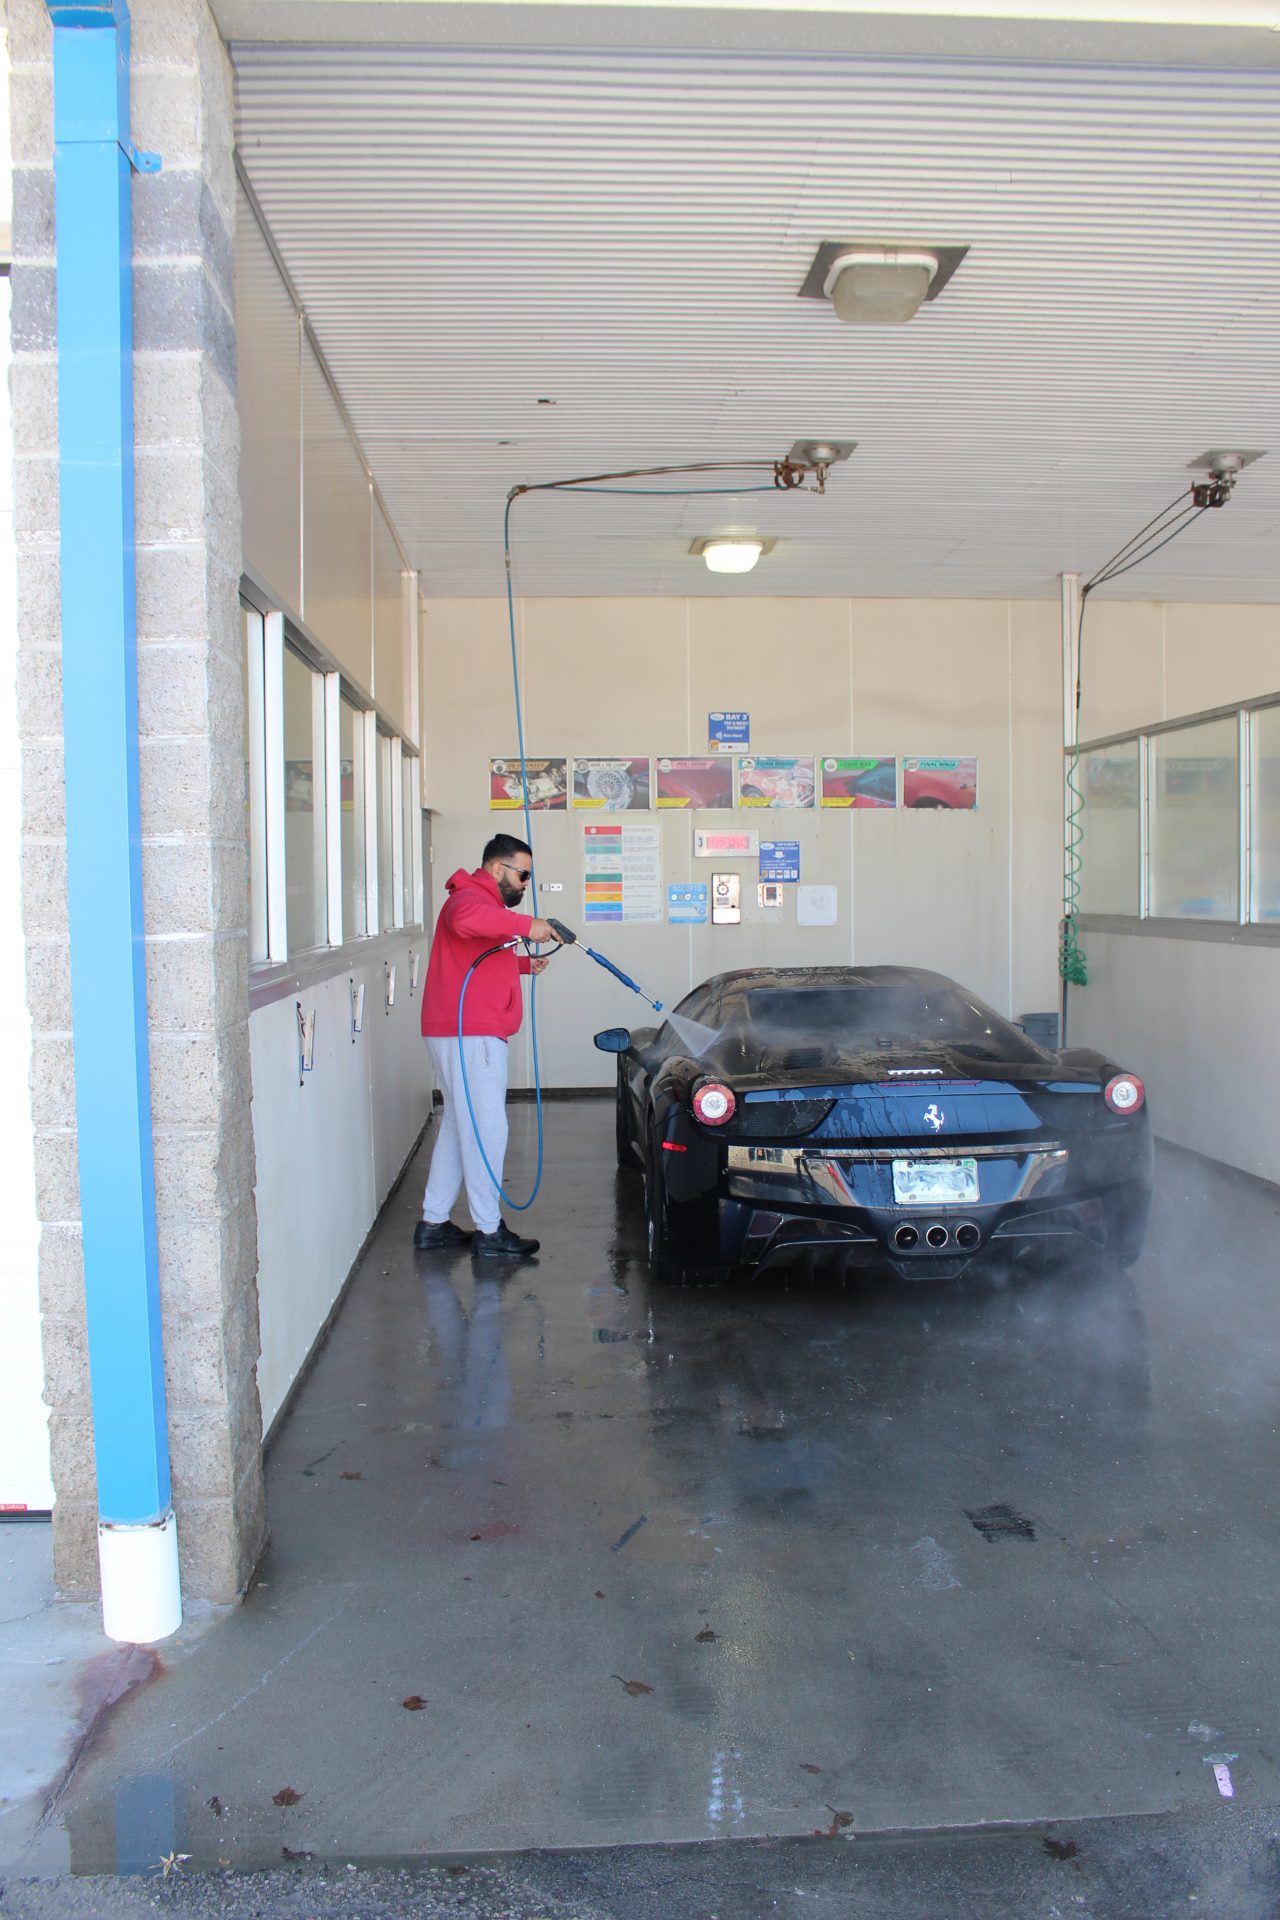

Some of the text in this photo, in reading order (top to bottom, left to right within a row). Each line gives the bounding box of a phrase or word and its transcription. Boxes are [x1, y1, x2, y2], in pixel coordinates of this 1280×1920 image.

[725, 713, 740, 721] BAY
[742, 713, 748, 721] 3
[698, 836, 703, 848] 3
